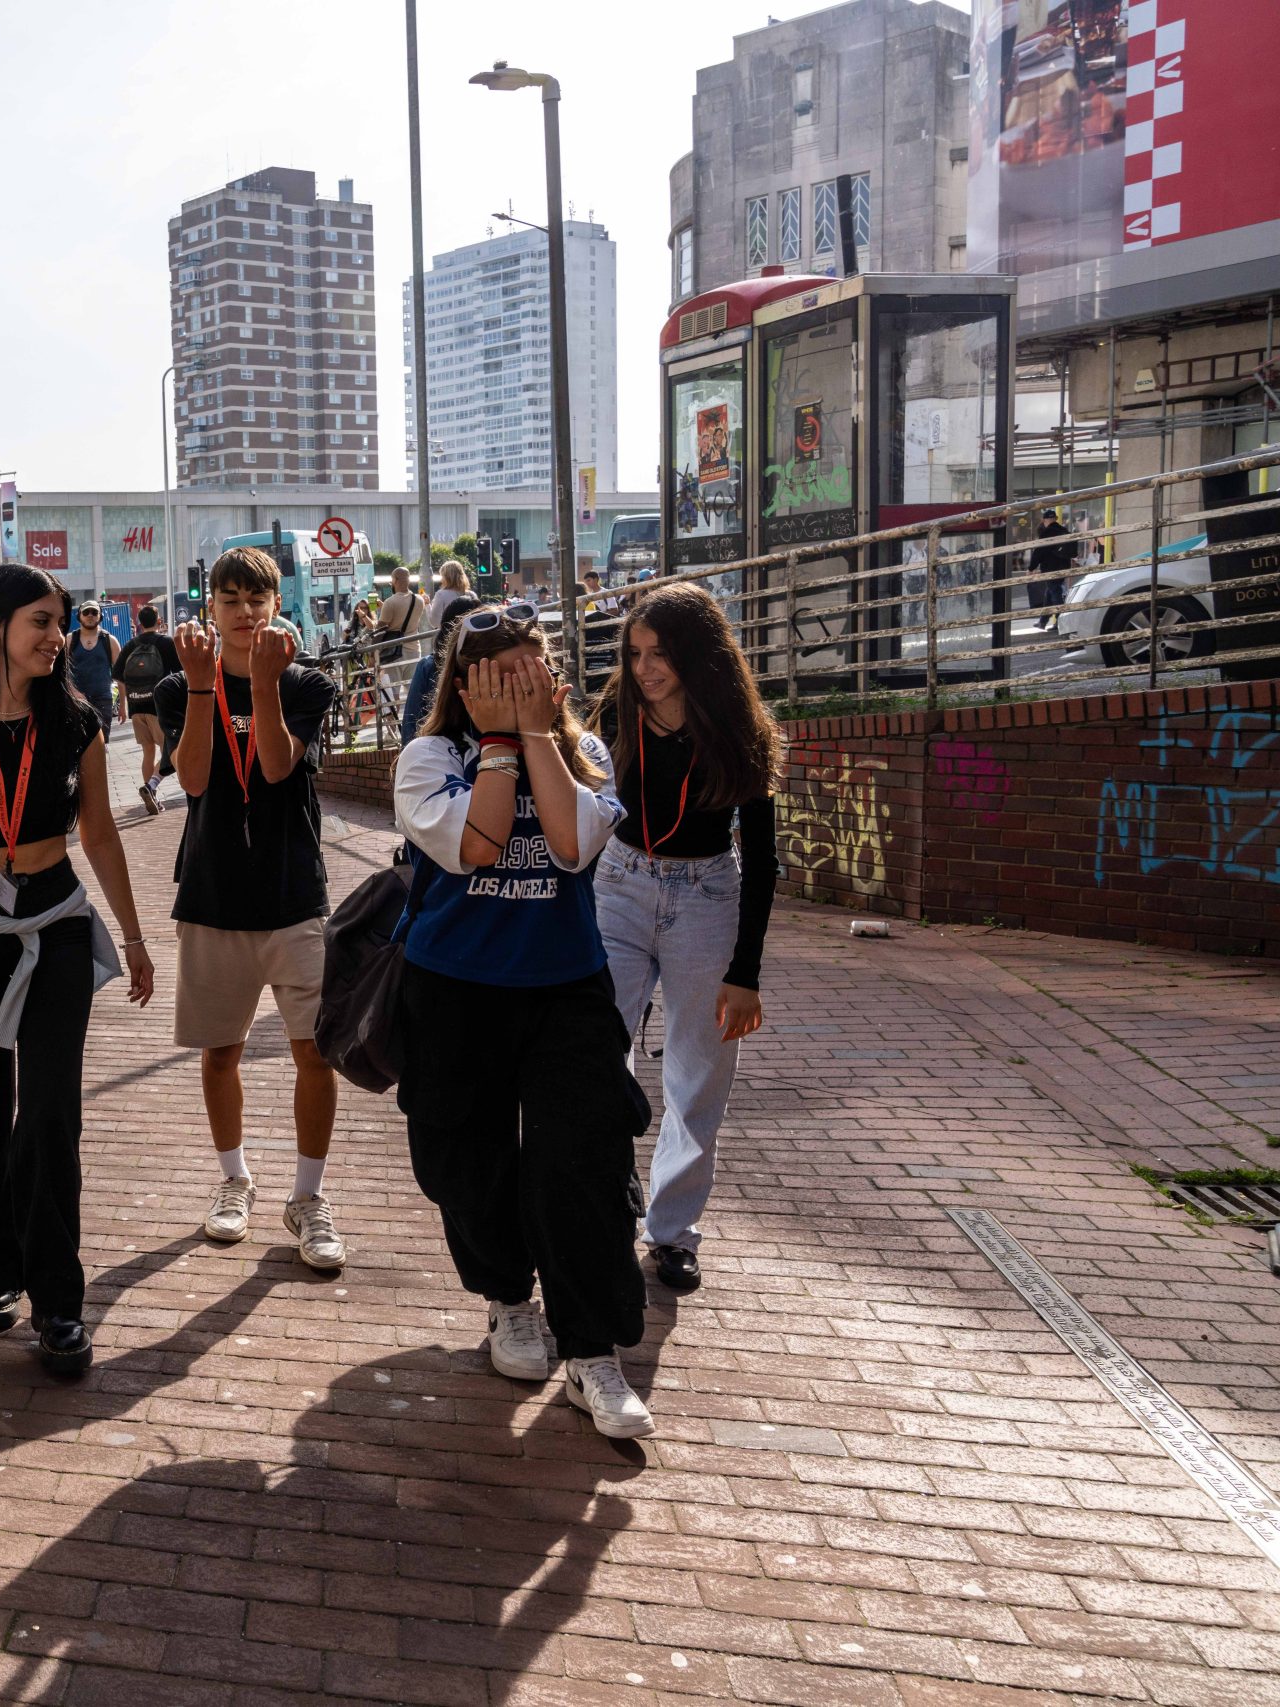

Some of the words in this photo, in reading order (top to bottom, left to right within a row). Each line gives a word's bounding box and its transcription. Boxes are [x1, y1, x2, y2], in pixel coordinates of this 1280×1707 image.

[123, 526, 153, 552] H&M
[32, 543, 62, 557] Sale
[1235, 588, 1268, 602] DOG
[467, 876, 500, 896] LOS
